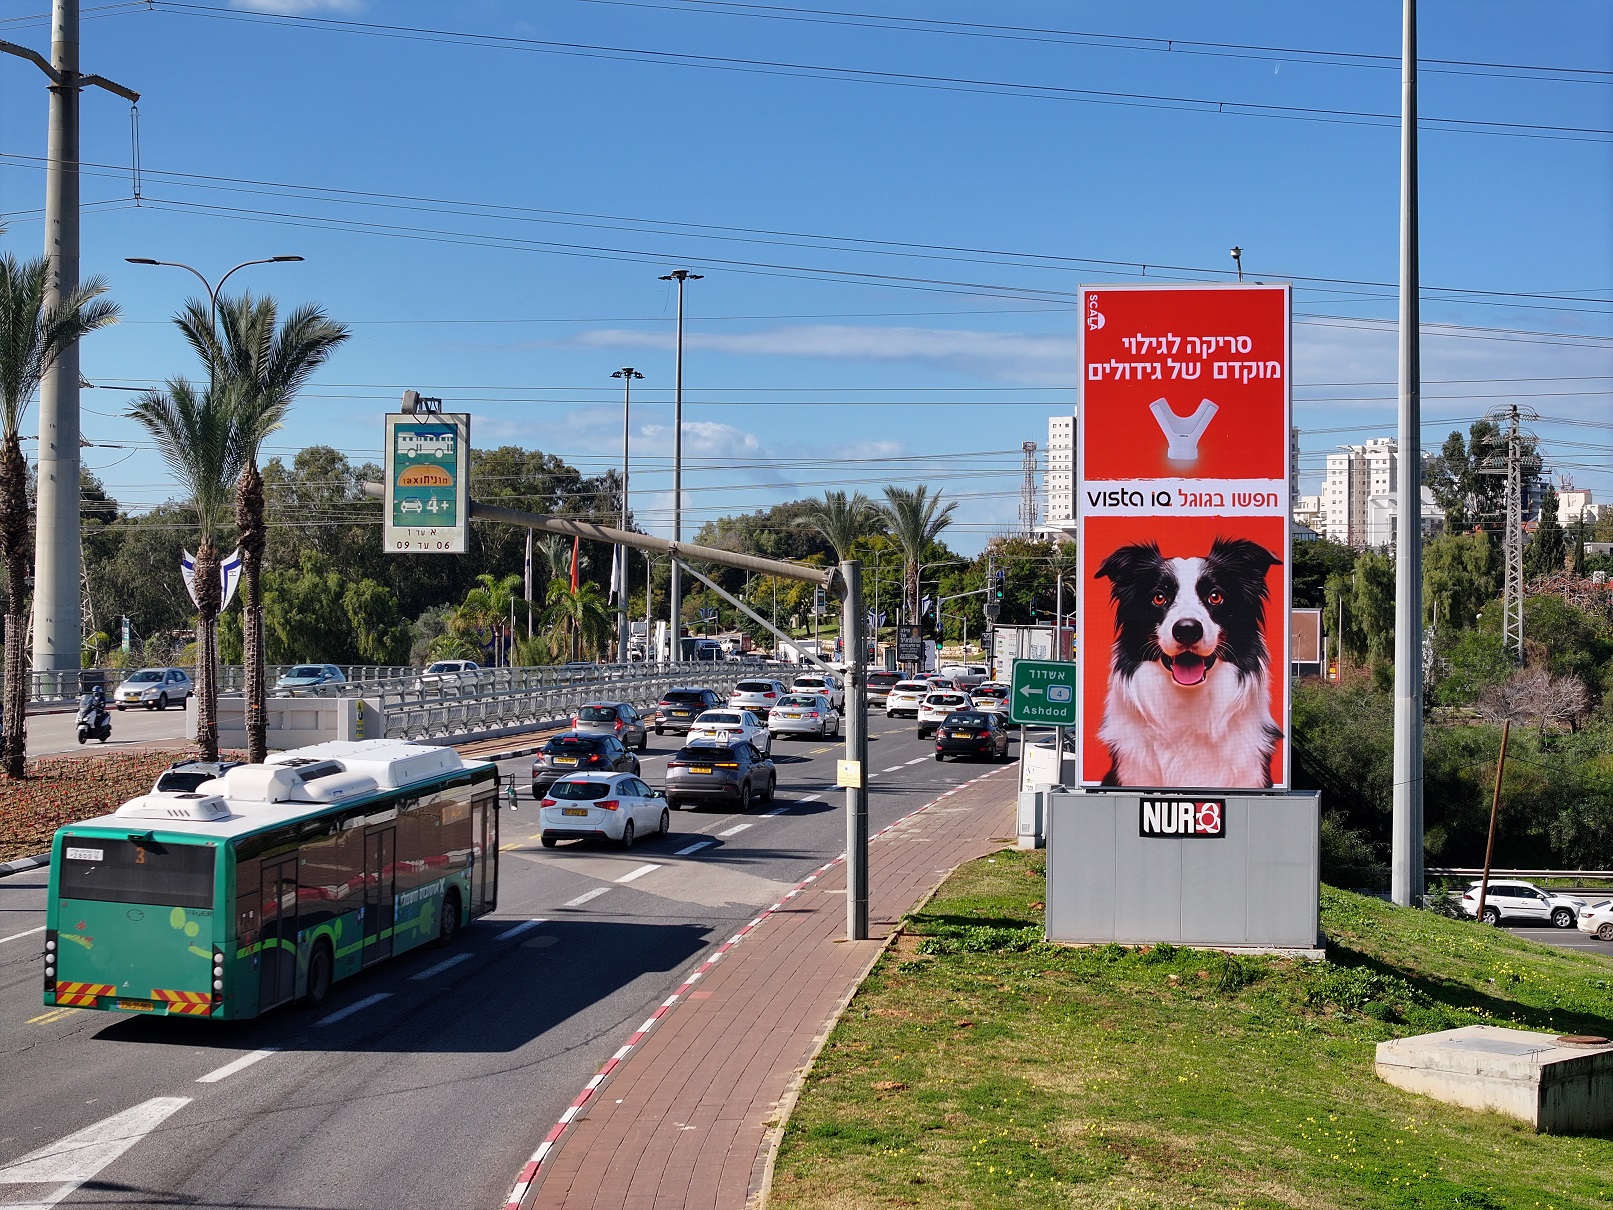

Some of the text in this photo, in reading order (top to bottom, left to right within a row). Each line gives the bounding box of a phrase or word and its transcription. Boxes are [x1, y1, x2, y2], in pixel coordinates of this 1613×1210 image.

[1090, 294, 1098, 331] SCALA
[1122, 332, 1252, 359] סריקה לגילוי
[1088, 358, 1281, 385] מוקדם של גידולים
[1178, 488, 1278, 508] חפשו בגוגל
[415, 529, 426, 537] עד
[396, 541, 450, 550] 06 עד 09
[1029, 670, 1066, 680] אשדוד
[1056, 690, 1063, 698] 4
[1022, 705, 1067, 717] Ashdod
[1143, 802, 1195, 834] NUR
[135, 847, 146, 864] 3
